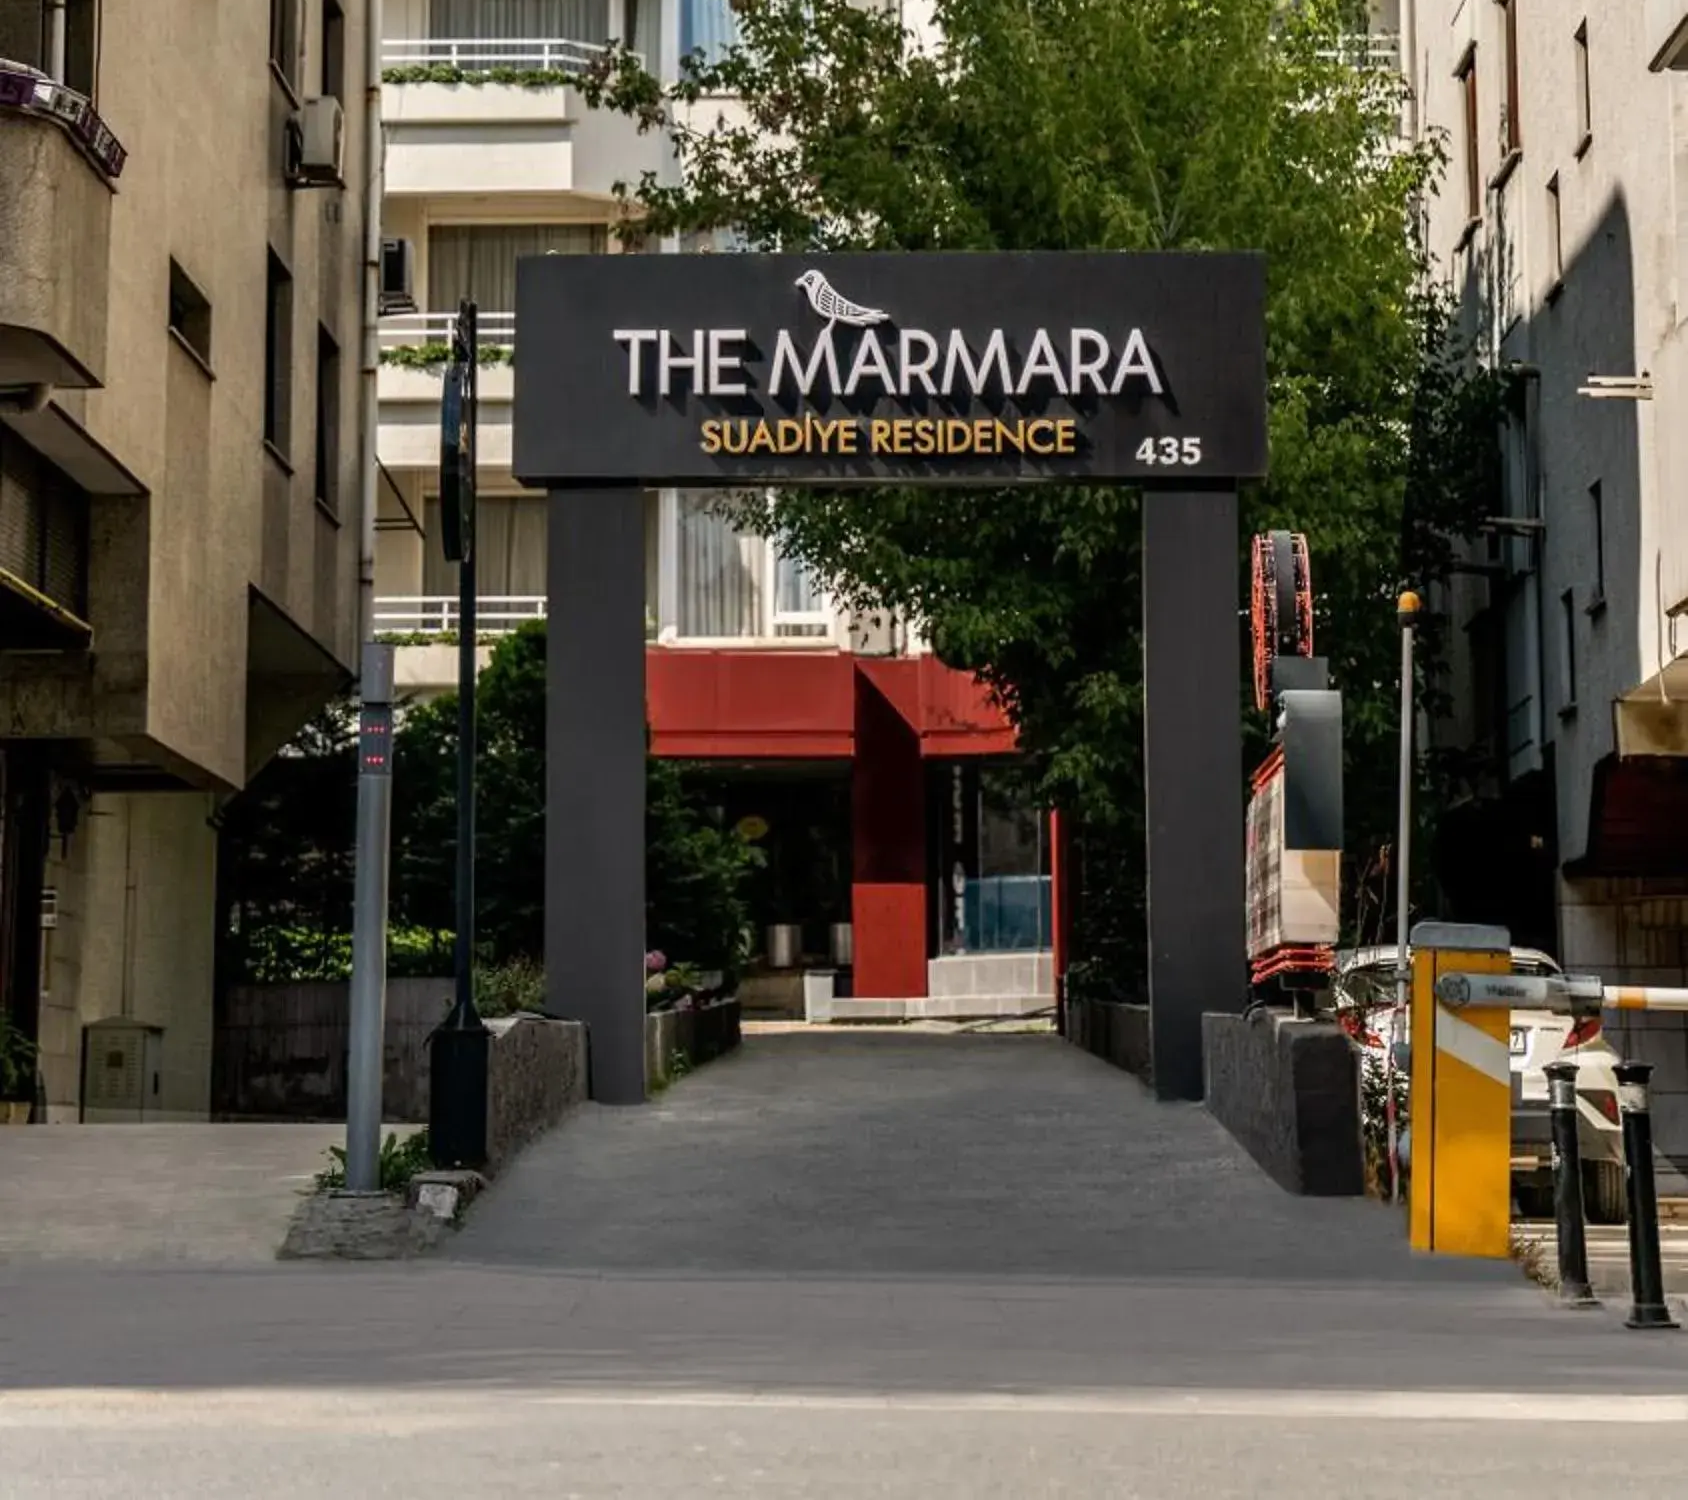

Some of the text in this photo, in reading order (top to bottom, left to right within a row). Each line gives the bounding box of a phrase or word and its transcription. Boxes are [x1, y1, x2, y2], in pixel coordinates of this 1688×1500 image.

[612, 328, 1163, 395] THE MARMARA
[870, 418, 1076, 453] RESIDENCE
[1135, 436, 1202, 466] 435
